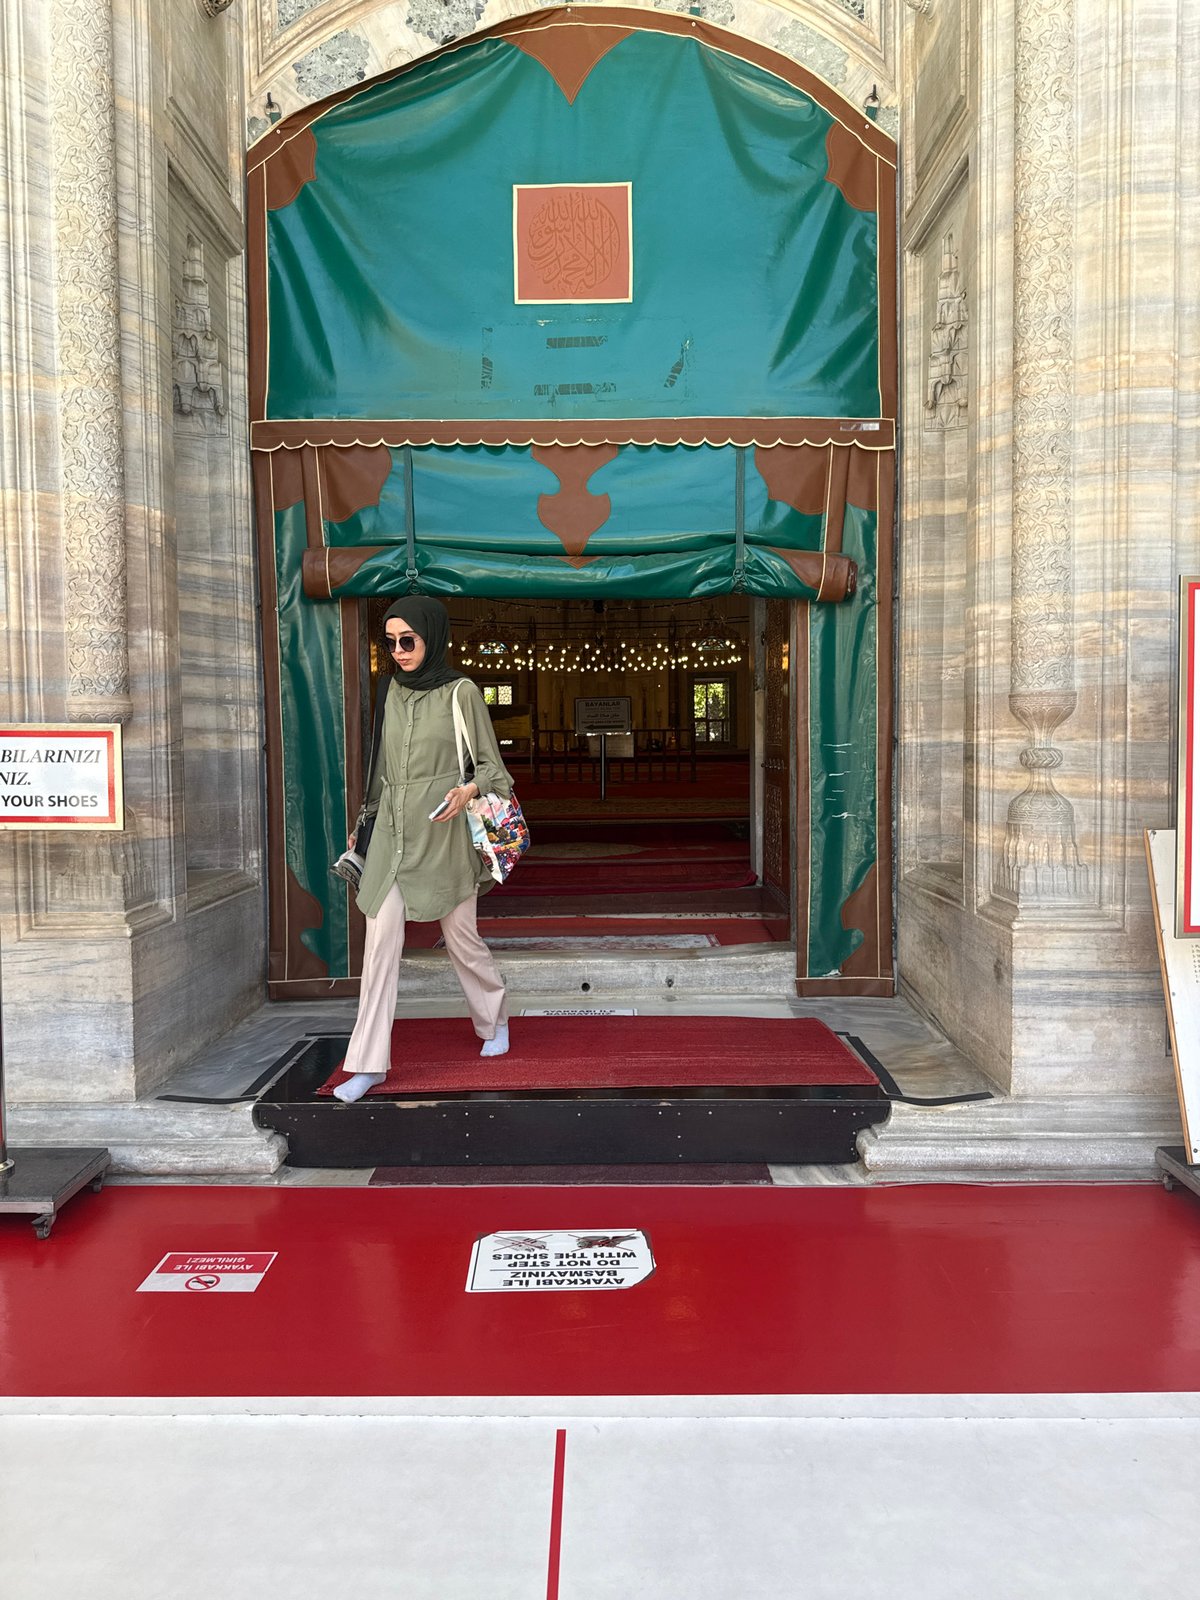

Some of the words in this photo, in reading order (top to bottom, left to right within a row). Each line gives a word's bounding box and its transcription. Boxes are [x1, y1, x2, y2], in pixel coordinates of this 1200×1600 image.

[2, 795, 44, 807] YOUR
[48, 795, 98, 807] SHOES
[510, 1270, 618, 1278] BASMAYINIZ
[502, 1279, 530, 1287] İLE
[536, 1278, 625, 1286] AYAKKABI
